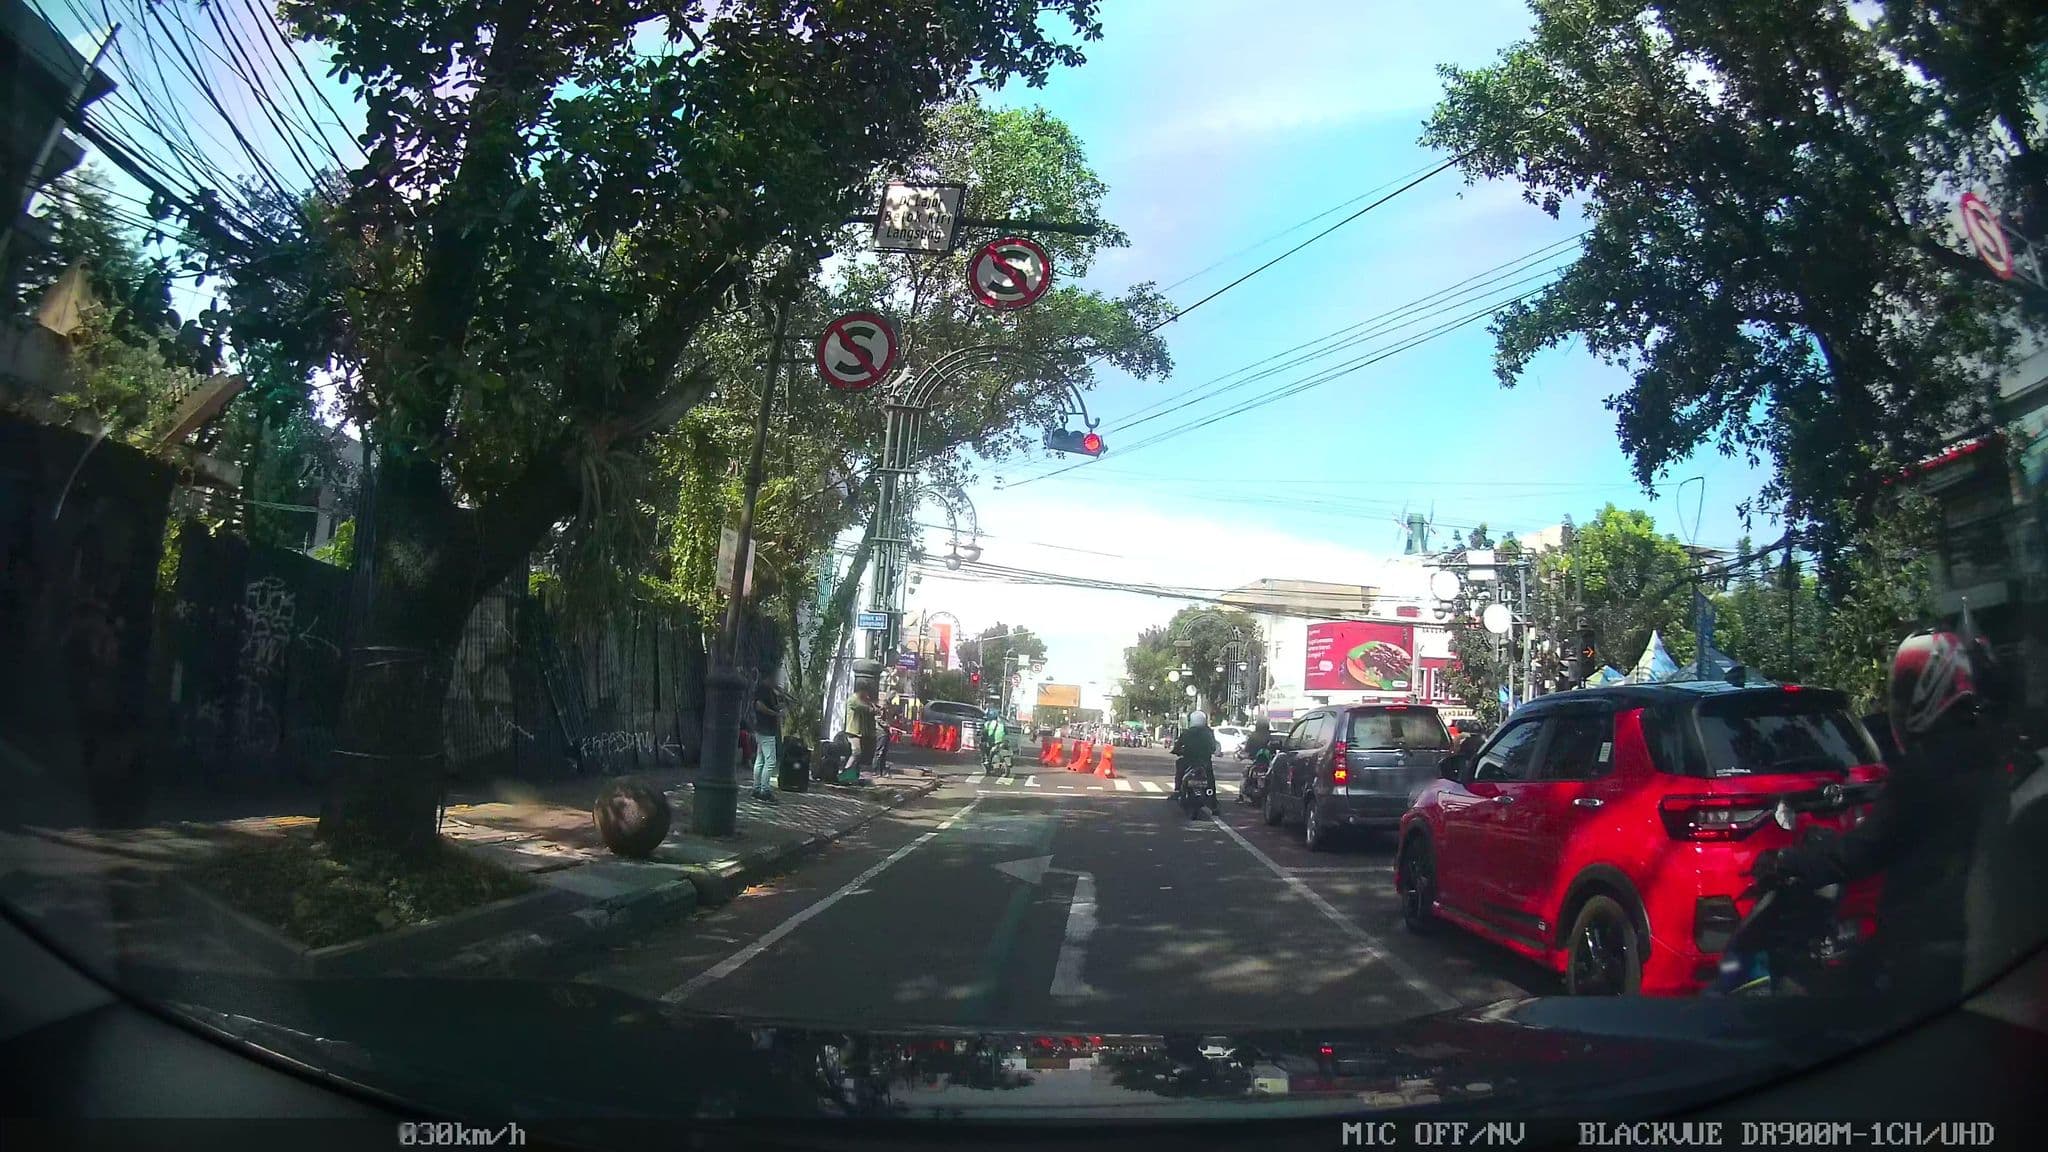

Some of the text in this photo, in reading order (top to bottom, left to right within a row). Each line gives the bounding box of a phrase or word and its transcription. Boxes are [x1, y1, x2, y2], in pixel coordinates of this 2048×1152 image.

[884, 210, 952, 225] Belok Kiri
[886, 226, 942, 244] Langsung
